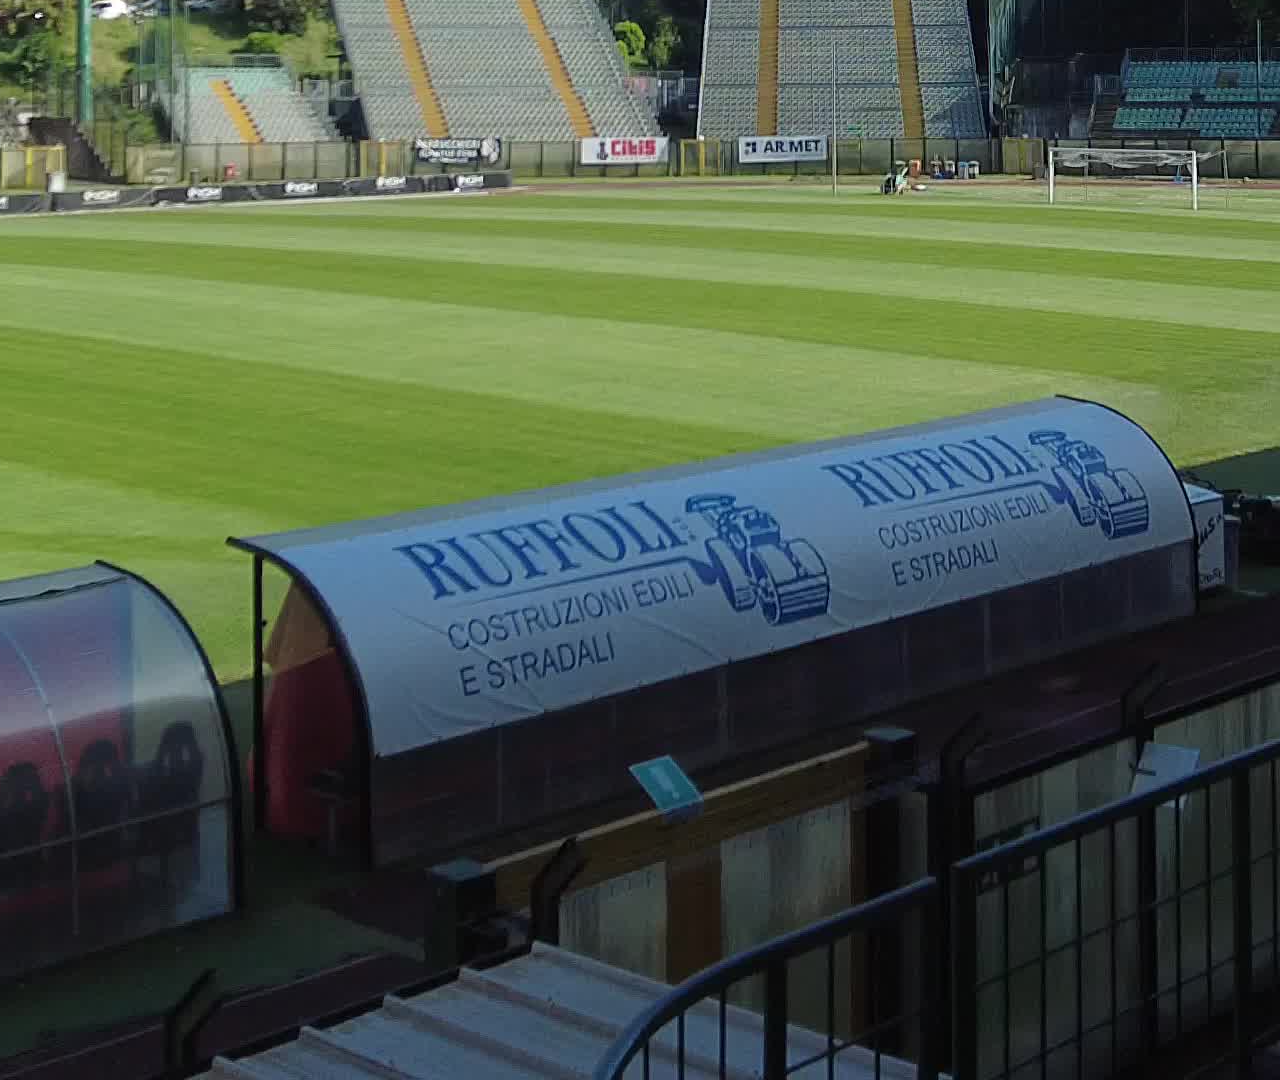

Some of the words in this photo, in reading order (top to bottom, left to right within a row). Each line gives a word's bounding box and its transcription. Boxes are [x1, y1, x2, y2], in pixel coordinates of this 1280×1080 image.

[821, 434, 1040, 508] RUFFOLI
[392, 500, 689, 601] RUFFOLI
[877, 505, 1006, 550] COSTRUZIONI
[1008, 492, 1051, 519] EDILI
[891, 561, 907, 587] E
[910, 538, 1001, 583] STRADALI
[447, 588, 630, 651] COSTRUZIONI
[630, 572, 696, 609] EDILI
[459, 665, 481, 697] E
[486, 631, 616, 690] STRADALI
